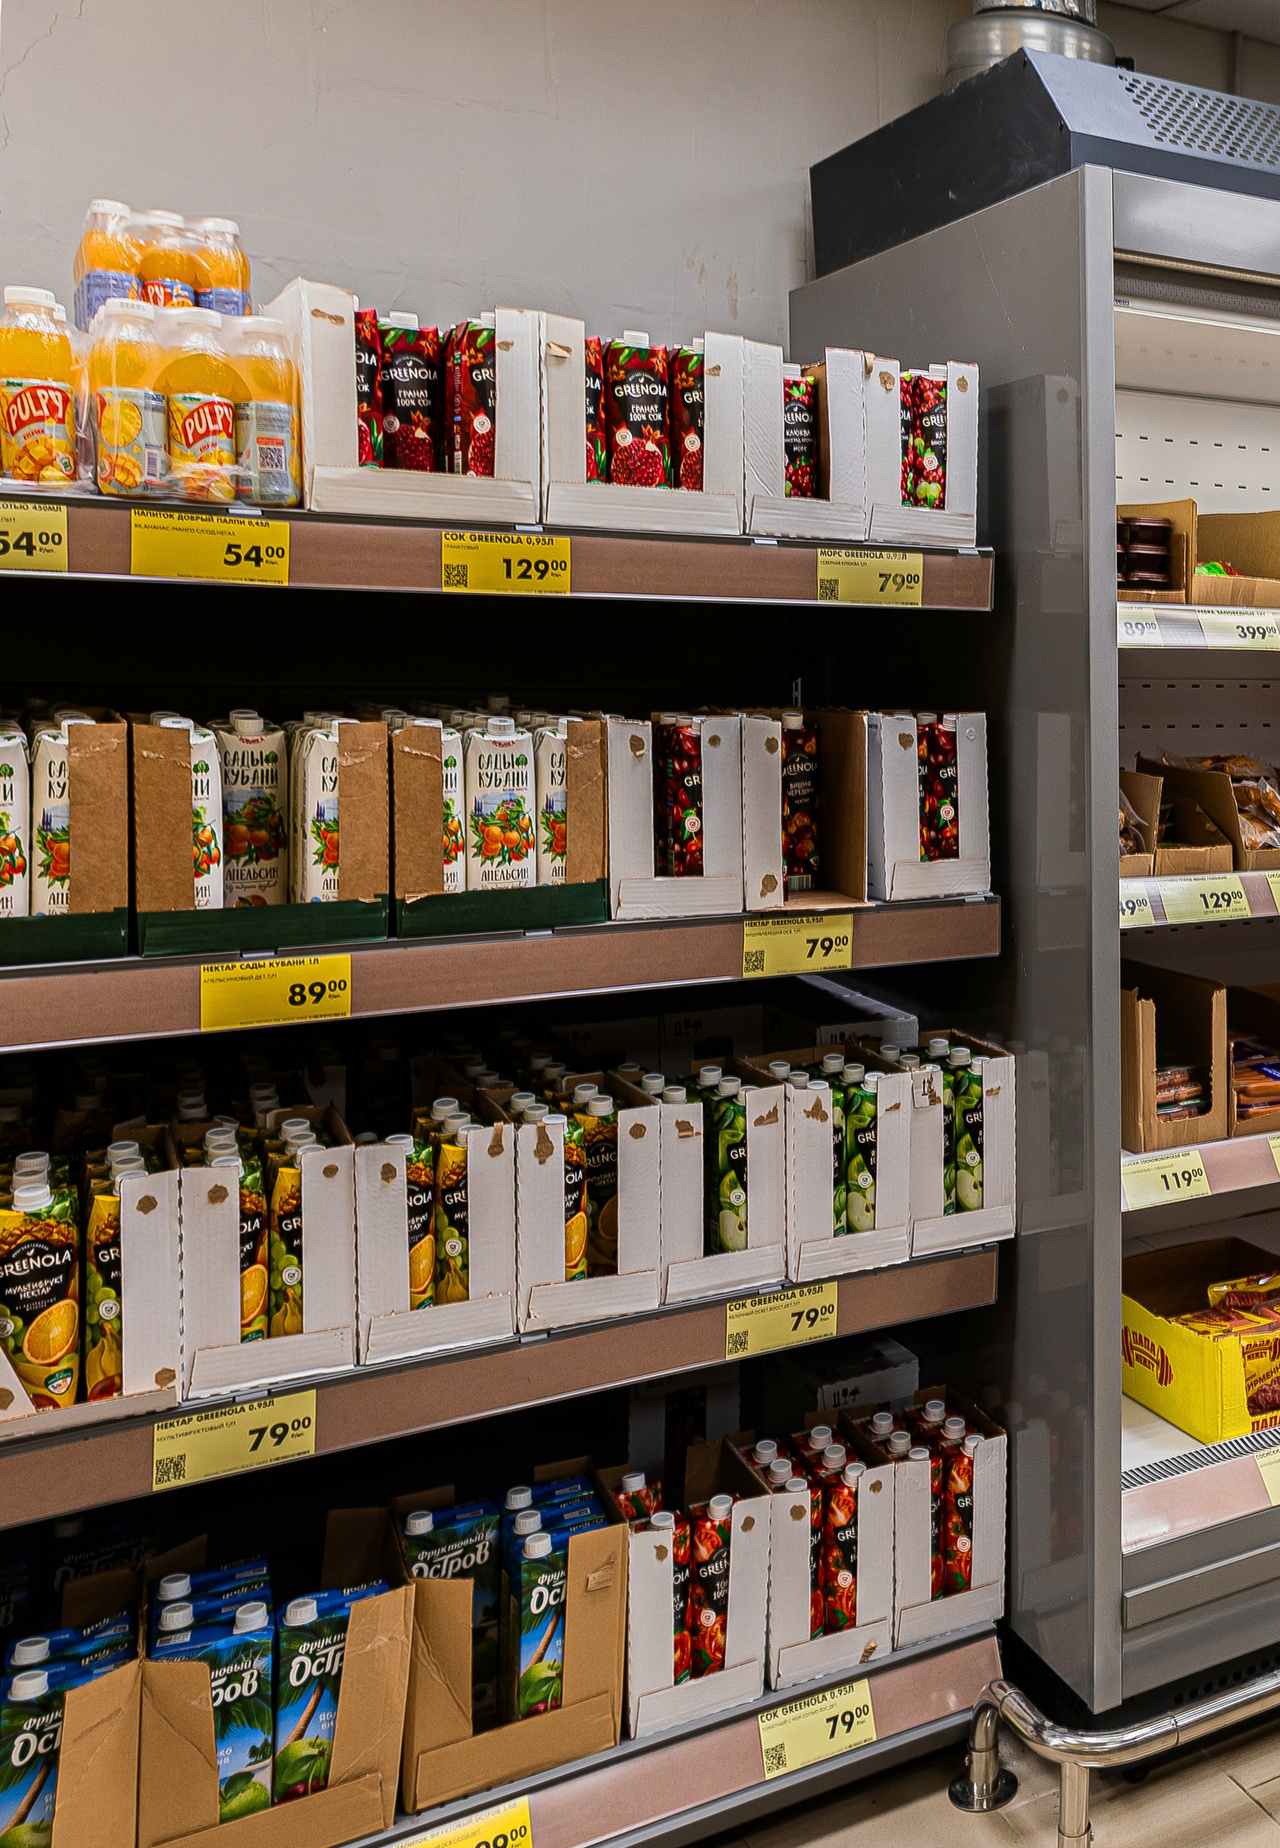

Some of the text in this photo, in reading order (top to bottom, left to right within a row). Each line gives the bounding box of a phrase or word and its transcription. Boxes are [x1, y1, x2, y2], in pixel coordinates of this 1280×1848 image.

[381, 367, 438, 382] GREENOLA
[398, 390, 429, 399] ГРАНАТ
[614, 384, 667, 397] GREENOLA
[9, 388, 64, 430] PULPY
[631, 404, 659, 413] ГРАНАТ
[650, 412, 663, 421] СОК
[184, 402, 234, 447] PULPY
[0, 503, 29, 512] ОТЬЮ
[133, 510, 174, 520] НАПИТОК
[177, 513, 214, 523] ДОБРЫЙ
[216, 516, 246, 525] ПАЛПИ
[444, 533, 466, 542] СОК
[470, 534, 523, 545] GREENOLA
[820, 550, 843, 558] МОРС
[845, 551, 884, 560] GREENOLA
[223, 749, 265, 767] САДЫ
[478, 753, 516, 770] САДЫ
[223, 768, 279, 786] КУБАНИ
[478, 771, 529, 788] КУБАНИ
[226, 867, 279, 882] АПЕЛЬСИН
[481, 867, 529, 881] АПЕЛЬСИН
[745, 920, 770, 928] НЕКТАР
[771, 918, 804, 927] GREENOLA
[203, 964, 236, 973] НЕКТАР
[240, 962, 265, 971] САДЫ
[269, 960, 305, 968] КУБАНИ
[5, 1275, 63, 1297] МУЛЬТИФРУКТ
[19, 1286, 52, 1300] НЕКТАР
[728, 1302, 747, 1312] СОК
[750, 1292, 796, 1307] GREENOLA
[1132, 1332, 1156, 1356] ПАПА
[1245, 1339, 1271, 1351] ПАПА
[1135, 1353, 1155, 1372] МОЖЕТ
[1246, 1351, 1267, 1362] МОЖЕТ
[157, 1416, 193, 1431] НЕКТАР
[196, 1406, 245, 1423] GREENOLA
[418, 1532, 485, 1560] Фруктовый
[760, 1712, 779, 1723] СОК
[782, 1695, 827, 1716] GREENOLA
